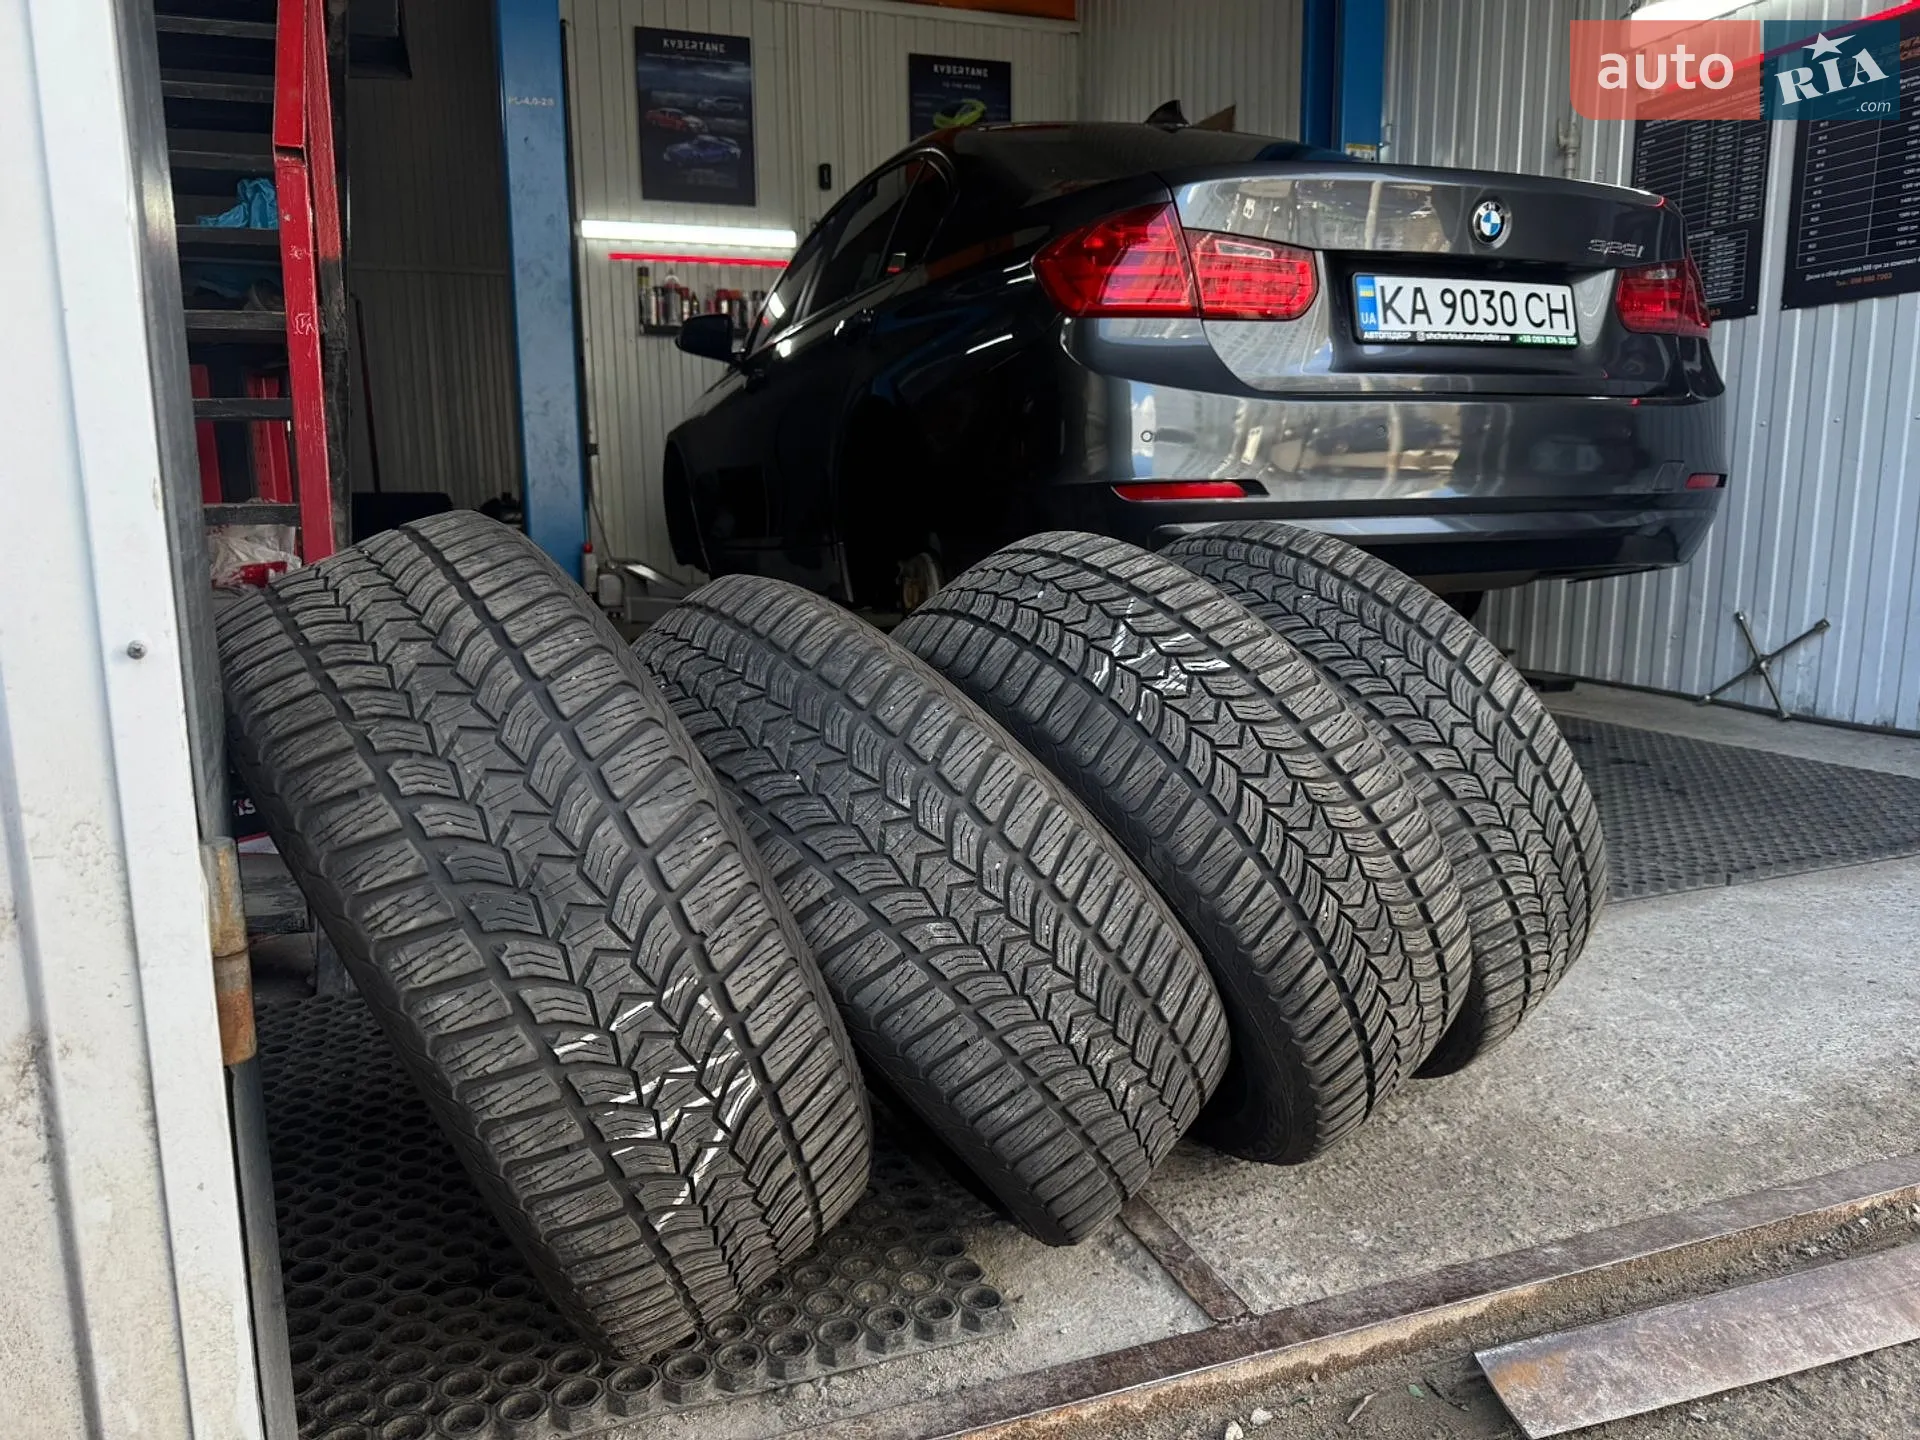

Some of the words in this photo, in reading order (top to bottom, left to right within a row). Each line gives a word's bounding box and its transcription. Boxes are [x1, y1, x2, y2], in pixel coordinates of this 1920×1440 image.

[1361, 311, 1377, 325] UA
[1380, 285, 1432, 326] KA
[1440, 287, 1518, 327] 9030
[1525, 291, 1570, 330] CH
